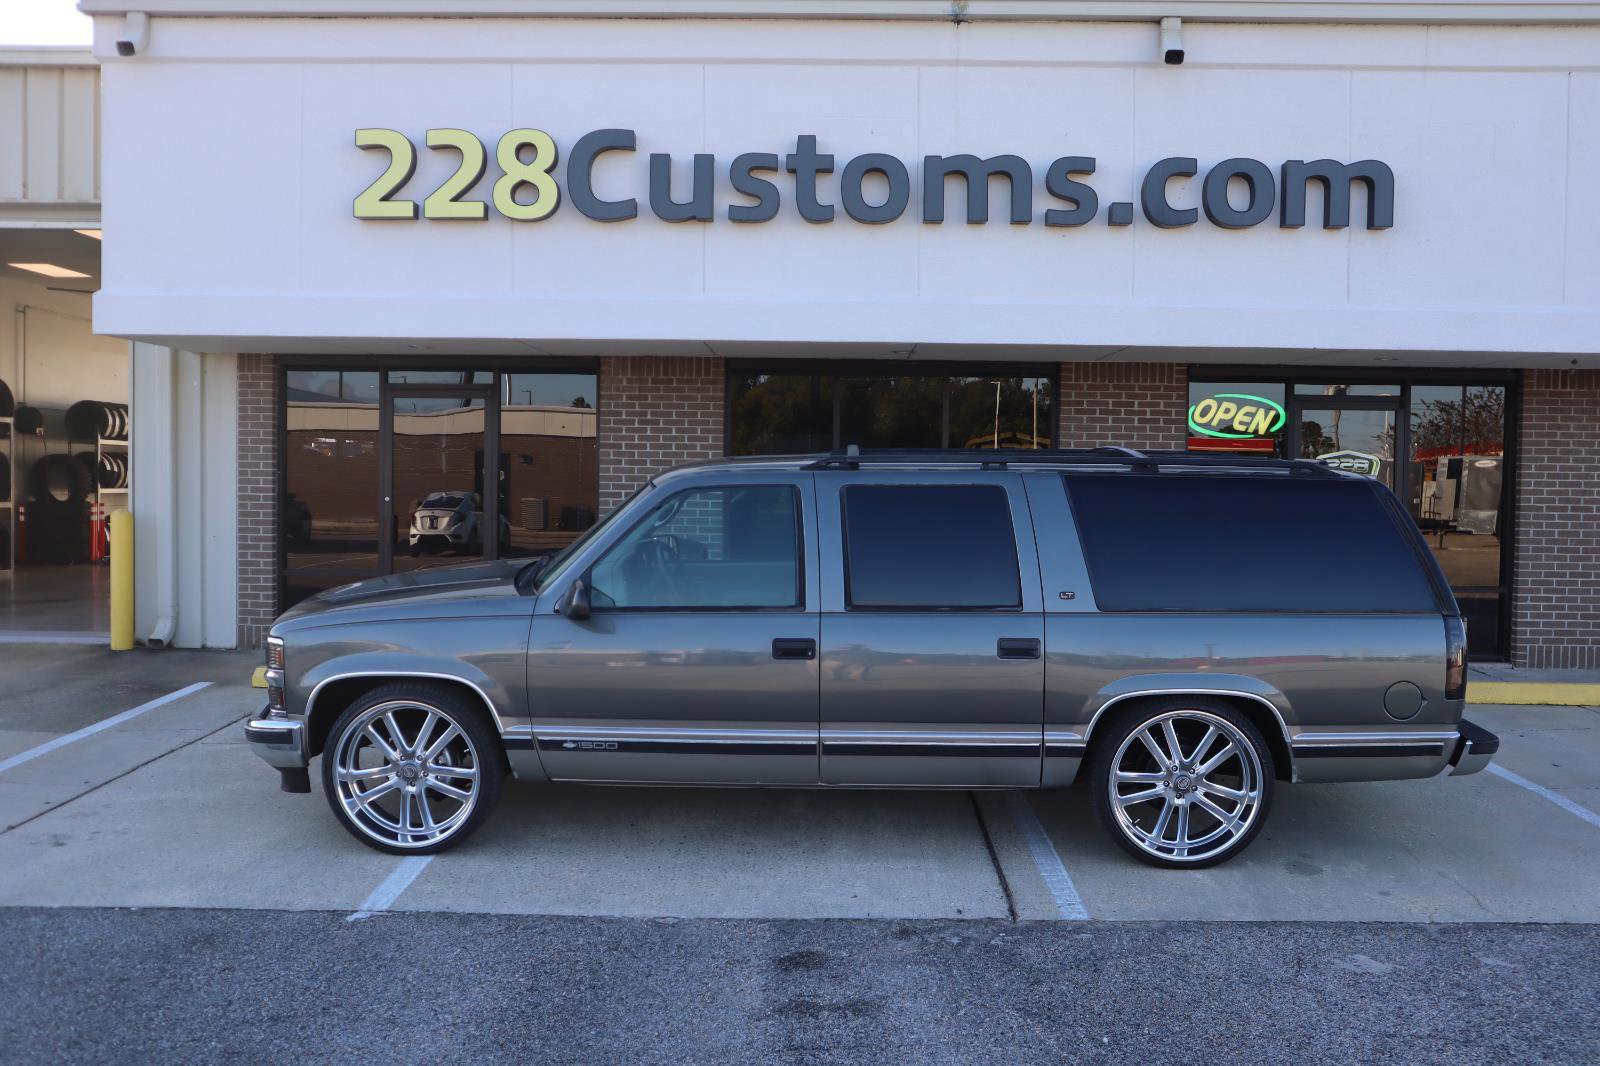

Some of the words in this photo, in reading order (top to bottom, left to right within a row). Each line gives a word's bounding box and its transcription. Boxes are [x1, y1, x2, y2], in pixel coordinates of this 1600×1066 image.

[353, 128, 1394, 229] 228Customs.com
[1193, 398, 1276, 435] OPEN
[577, 741, 618, 749] 1500
